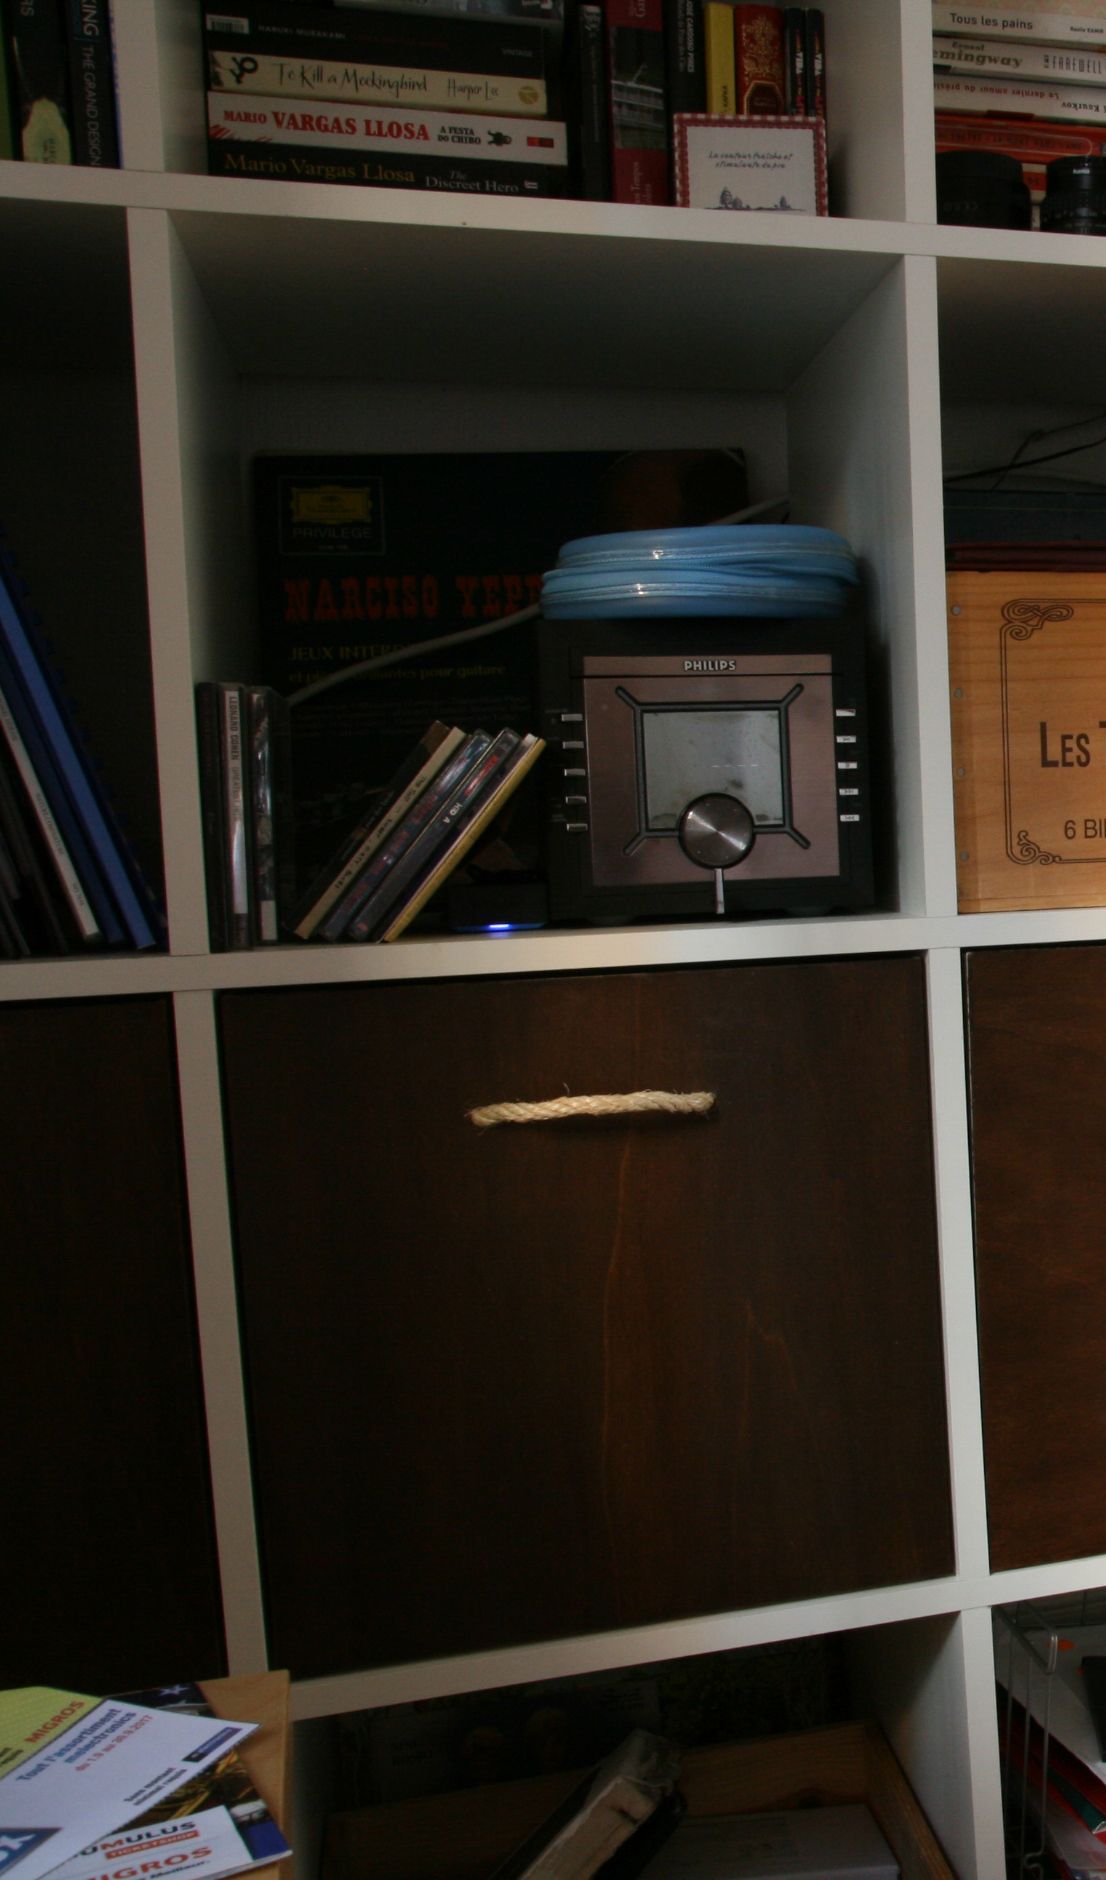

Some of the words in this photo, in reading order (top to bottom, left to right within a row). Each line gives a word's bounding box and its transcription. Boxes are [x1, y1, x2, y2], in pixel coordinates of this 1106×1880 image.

[82, 0, 99, 36] ING
[949, 12, 978, 27] Tous
[980, 15, 1000, 27] les
[1001, 17, 1033, 33] pains
[299, 28, 346, 39] MURAKAMI
[951, 40, 985, 51] Ernest
[82, 46, 95, 69] THE
[272, 62, 295, 84] To
[299, 64, 325, 89] Kill
[330, 74, 338, 84] a
[341, 68, 428, 98] Mockingbird
[446, 79, 483, 99] Harper
[963, 85, 976, 94] du
[83, 72, 98, 118] GRAND
[980, 87, 1009, 96] amour
[1013, 88, 1046, 99] dernier
[1049, 92, 1060, 100] Le
[1061, 100, 1100, 114] Kourkov
[224, 110, 267, 124] MARIO
[271, 110, 358, 136] VARGAS
[364, 119, 430, 141] LLOSA
[440, 126, 448, 136] A
[449, 126, 475, 137] FESTA
[86, 121, 101, 165] DESIGN
[437, 134, 449, 143] DO
[224, 153, 288, 174] Mario
[291, 157, 357, 182] Vargas
[362, 162, 416, 184] Llosa
[425, 174, 481, 192] Discreet
[484, 178, 520, 194] Hero
[289, 527, 373, 540] PRIVILEGE
[281, 576, 440, 622] NARCISO
[291, 643, 337, 661] JEUX
[683, 660, 737, 672] PHILIPS
[230, 734, 241, 761] COHEN
[1040, 721, 1091, 769] LES
[449, 802, 463, 816] KID
[1064, 819, 1077, 840] 6
[24, 1700, 86, 1744] MIGROS
[16, 1756, 51, 1781] Tout
